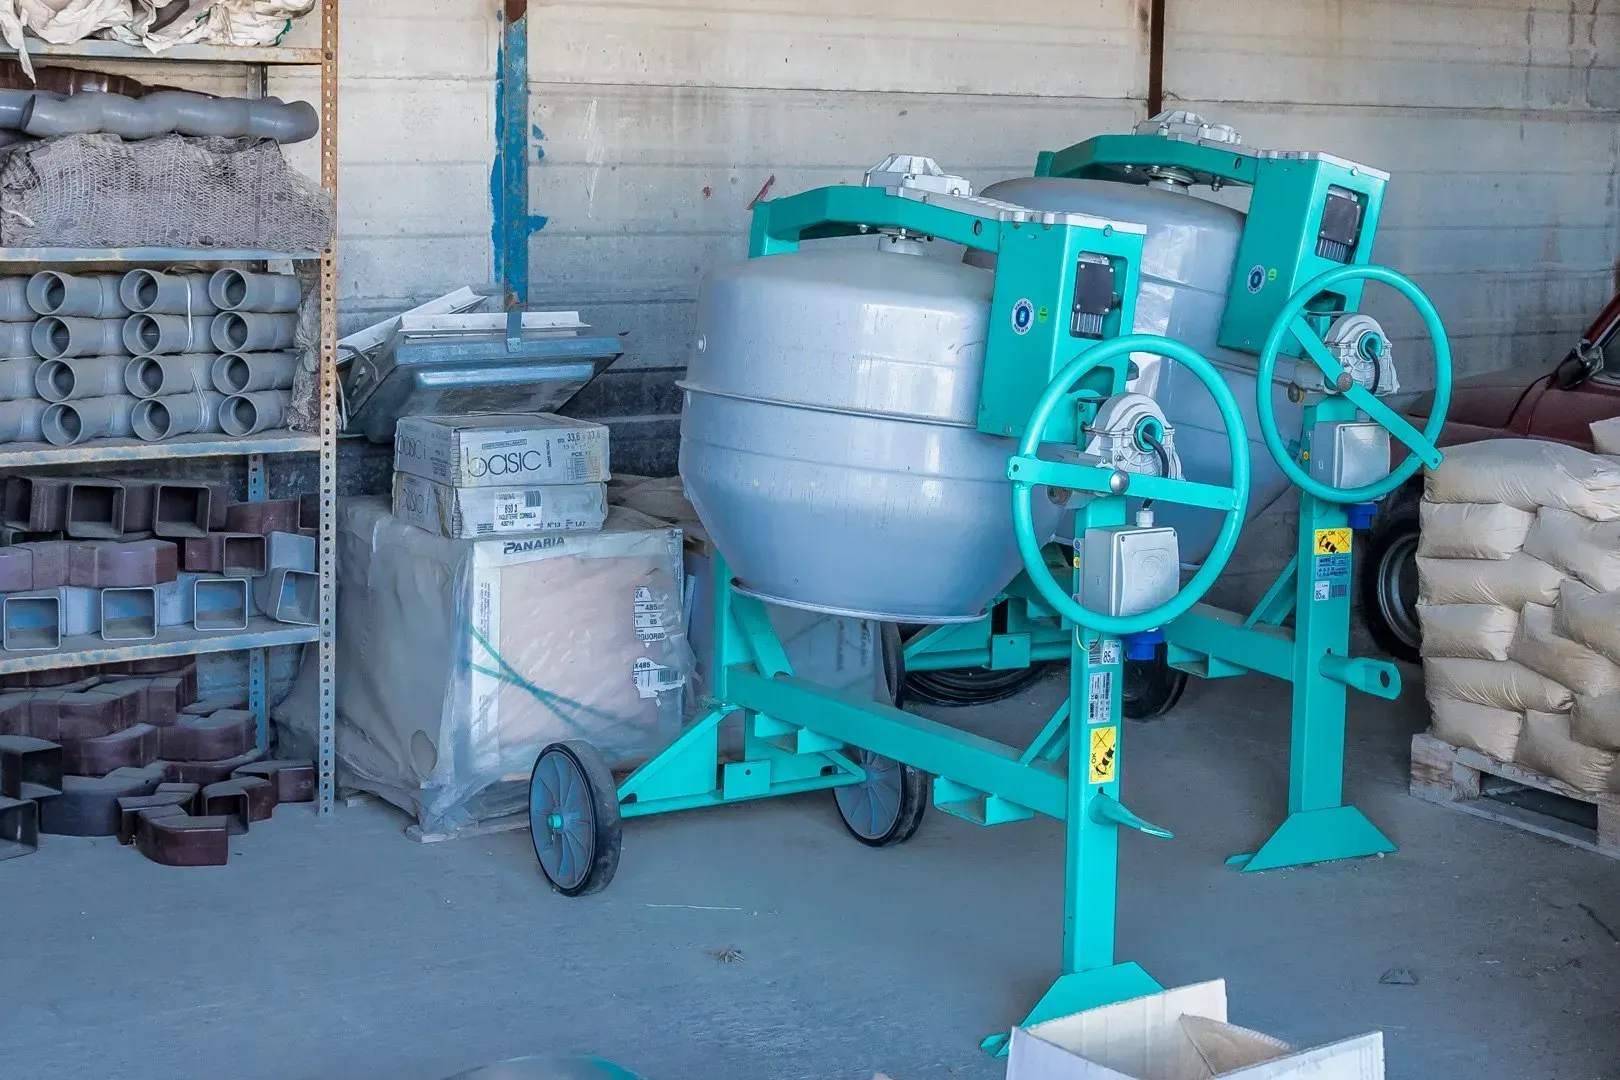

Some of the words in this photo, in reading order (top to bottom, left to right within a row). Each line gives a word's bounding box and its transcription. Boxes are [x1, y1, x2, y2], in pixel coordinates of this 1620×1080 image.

[465, 447, 542, 478] basic
[503, 536, 565, 554] PANARIA
[635, 590, 643, 599] 24
[1091, 752, 1097, 764] OK
